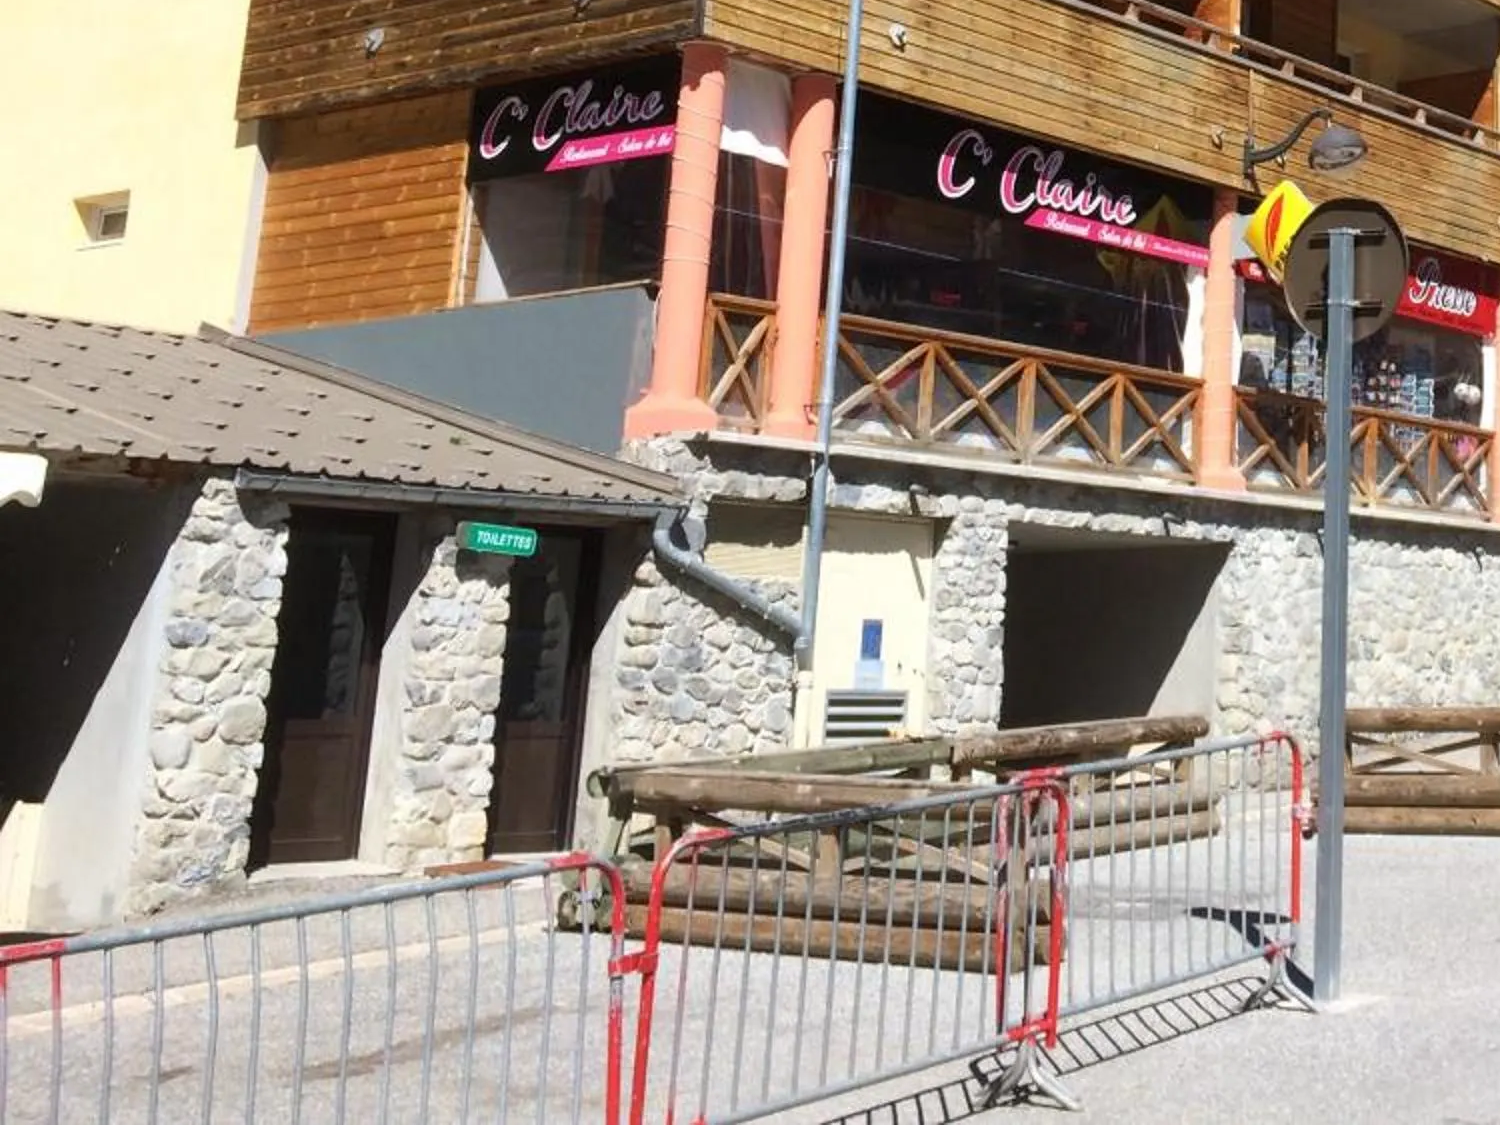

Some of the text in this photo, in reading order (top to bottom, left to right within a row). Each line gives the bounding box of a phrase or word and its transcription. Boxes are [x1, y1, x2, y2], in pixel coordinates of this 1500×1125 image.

[532, 78, 664, 151] Claire
[1000, 145, 1136, 225] Claire
[477, 530, 533, 550] TOILETTES
